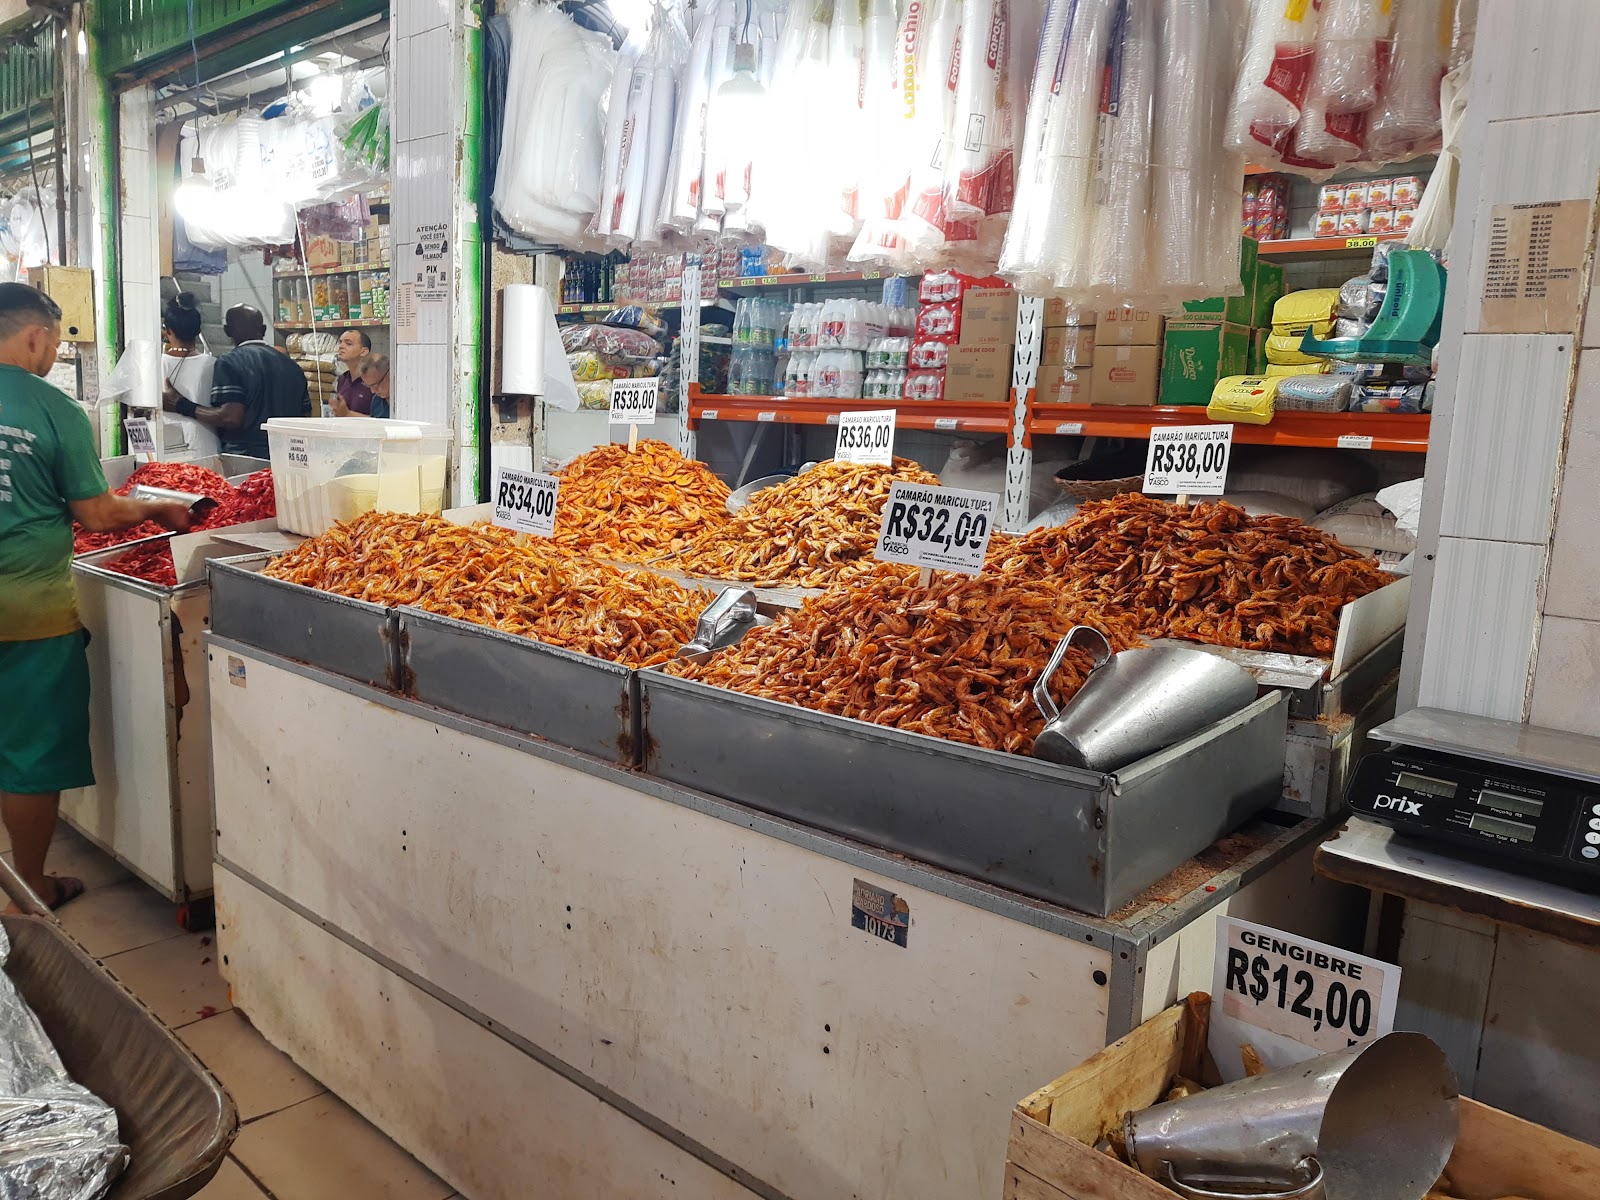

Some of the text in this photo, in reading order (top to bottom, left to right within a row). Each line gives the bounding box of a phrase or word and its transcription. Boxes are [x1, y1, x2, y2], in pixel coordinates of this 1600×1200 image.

[989, 18, 1001, 61] COPOS
[1513, 202, 1562, 210] DESCARTÁVEIS
[416, 223, 448, 233] ATENÇÃO
[420, 232, 433, 240] VOCÊ
[426, 265, 438, 274] PIX
[613, 381, 657, 389] CAMARÃO MARICULTURA
[613, 389, 655, 414] R$38,00
[862, 415, 892, 423] MARICULTURA
[839, 424, 890, 454] R$36,00
[1153, 430, 1229, 442] CAMARÃO MARICULTURA
[1151, 442, 1225, 479] R$38,00
[501, 471, 556, 490] CAMARÃO MARICULTURA
[498, 481, 554, 519] R$34,00
[895, 488, 992, 512] CAMARÃO MARICULTURA
[886, 502, 987, 553] R$32,00
[883, 543, 909, 555] VASCO
[1373, 793, 1424, 816] prix
[856, 886, 885, 906] ADRIANO
[863, 914, 896, 942] 10173
[1240, 931, 1363, 981] GENGIBRE
[1226, 947, 1371, 1037] R$12,00
